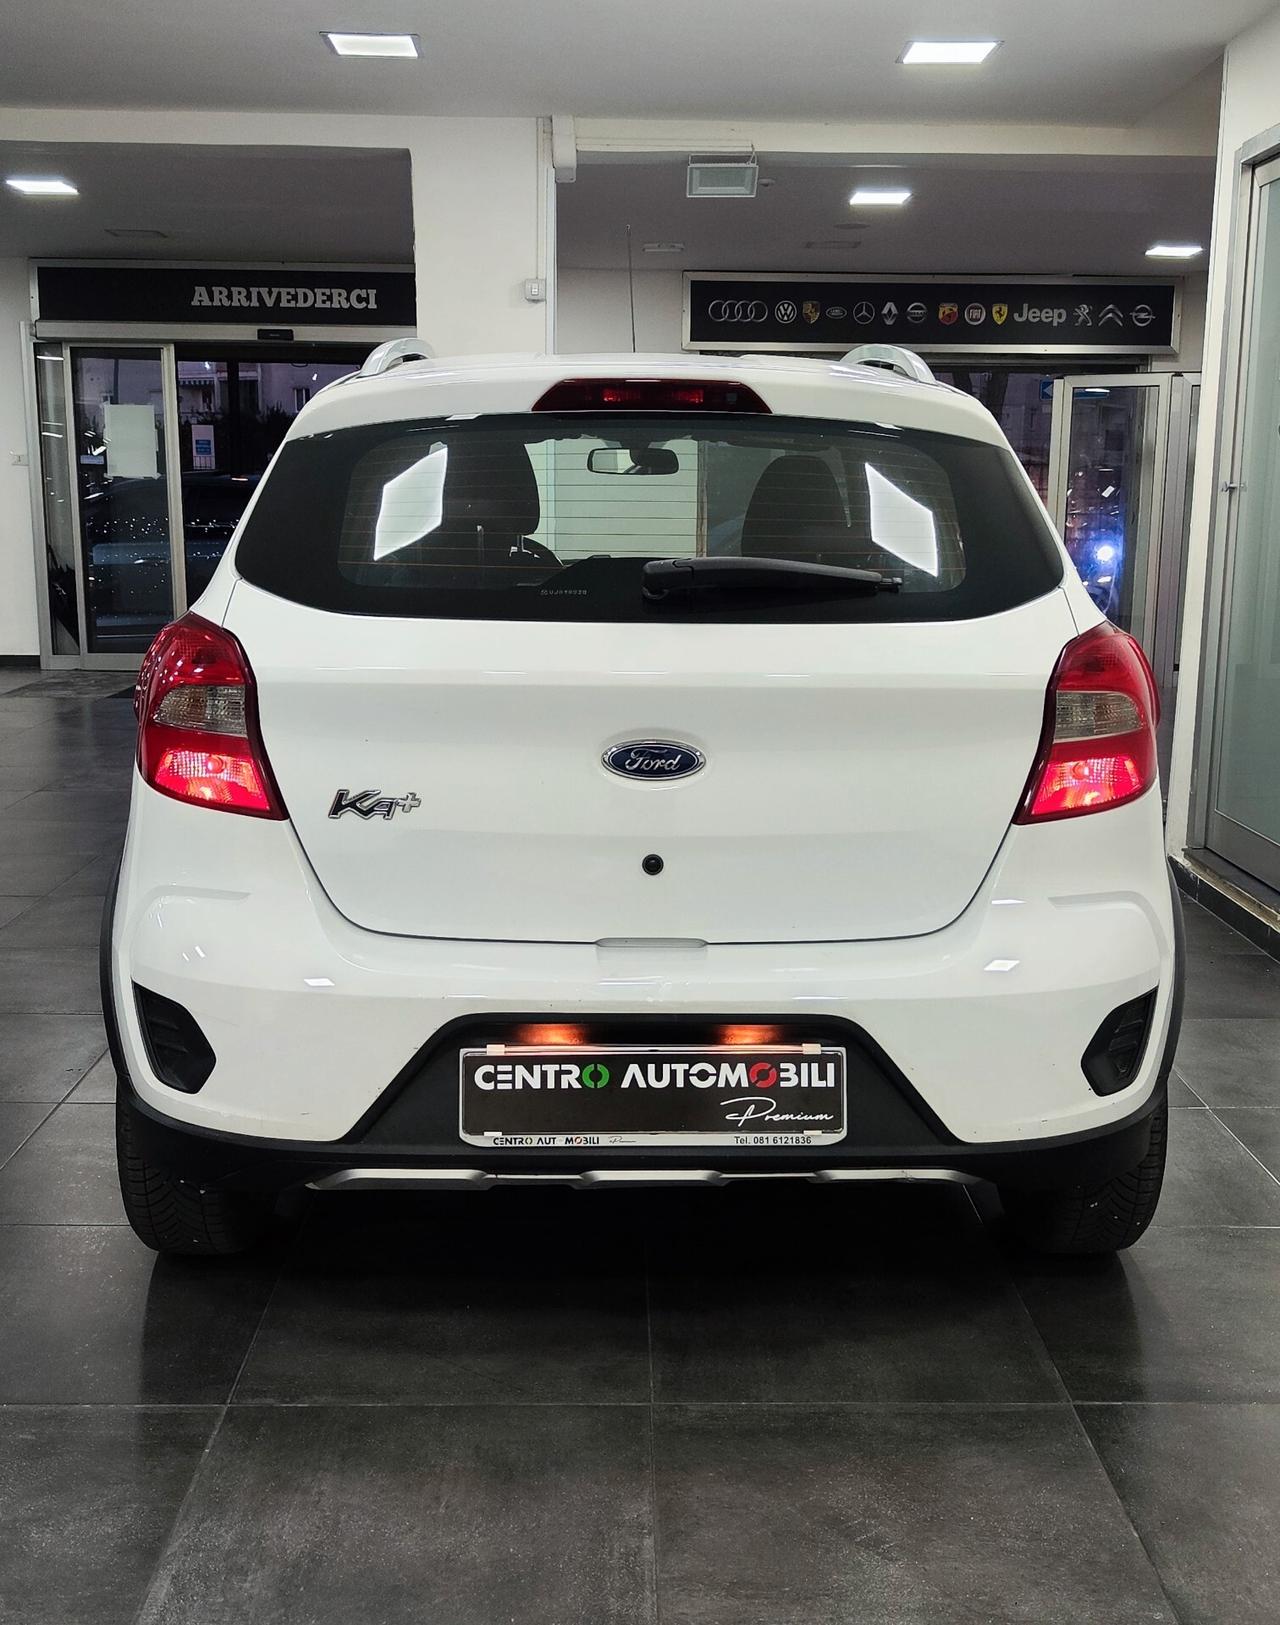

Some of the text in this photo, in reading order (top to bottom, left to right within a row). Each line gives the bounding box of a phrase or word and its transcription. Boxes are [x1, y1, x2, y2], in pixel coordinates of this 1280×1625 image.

[191, 286, 378, 309] ARRIVEDERCI
[1013, 303, 1067, 326] Jeep
[624, 747, 682, 771] Ford
[474, 1061, 836, 1091] CENTRO AUTOMOBILI
[720, 1096, 834, 1127] Premium
[493, 1137, 533, 1146] CENTRO
[734, 1136, 812, 1145] Tel. 081 6121836
